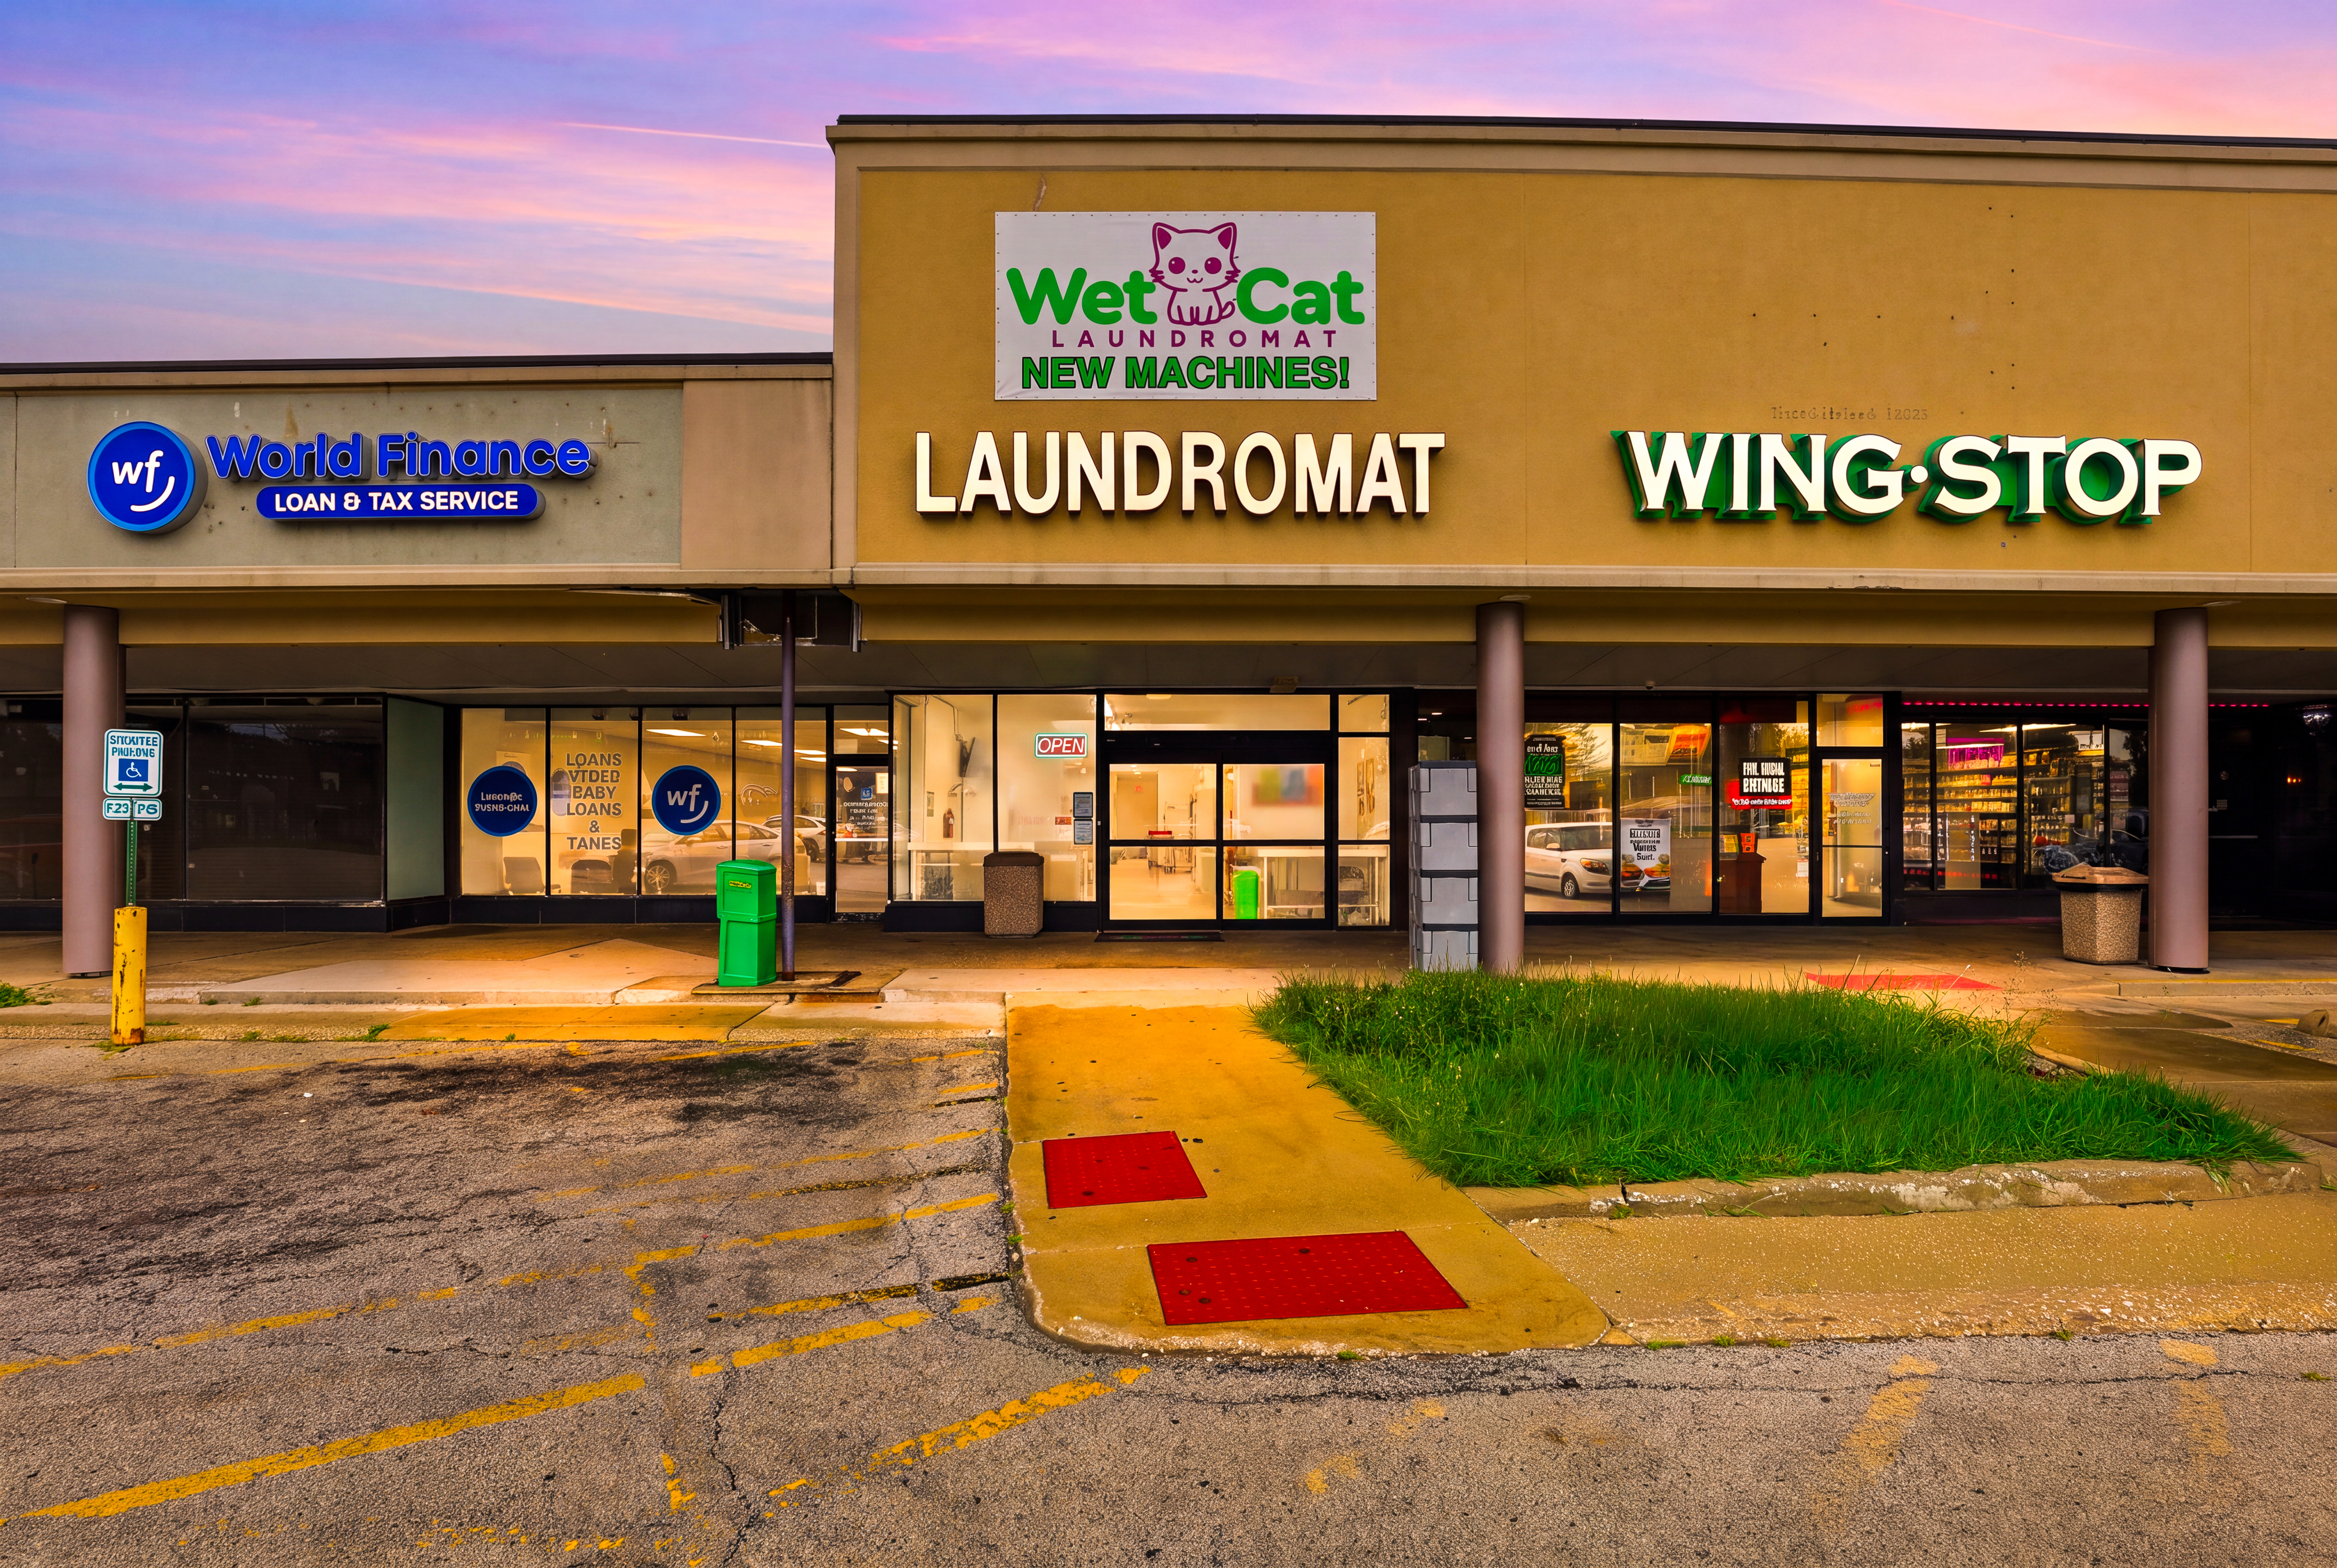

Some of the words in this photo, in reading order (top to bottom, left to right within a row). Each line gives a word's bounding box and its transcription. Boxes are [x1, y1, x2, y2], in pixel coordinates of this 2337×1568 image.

[1006, 267, 1157, 325] Wet
[1236, 267, 1365, 325] Cat
[1052, 330, 1336, 348] LAUNDROMAT
[1022, 356, 1114, 389] NEW
[1126, 355, 1349, 389] MACHINES!
[205, 432, 362, 479] World
[377, 430, 592, 479] Finance
[112, 450, 164, 493] wf
[915, 431, 1446, 515] LAUNDROMAT
[275, 493, 336, 512] LOAN
[344, 492, 361, 511] &
[369, 491, 414, 511] TAX
[420, 490, 519, 511] SERVICE
[1038, 738, 1084, 753] OPEN
[566, 753, 622, 766] LOANS
[573, 786, 617, 799] BABY
[667, 784, 701, 812] wf
[567, 802, 622, 816] LOANS
[589, 820, 600, 833] &
[567, 837, 621, 850] TANES
